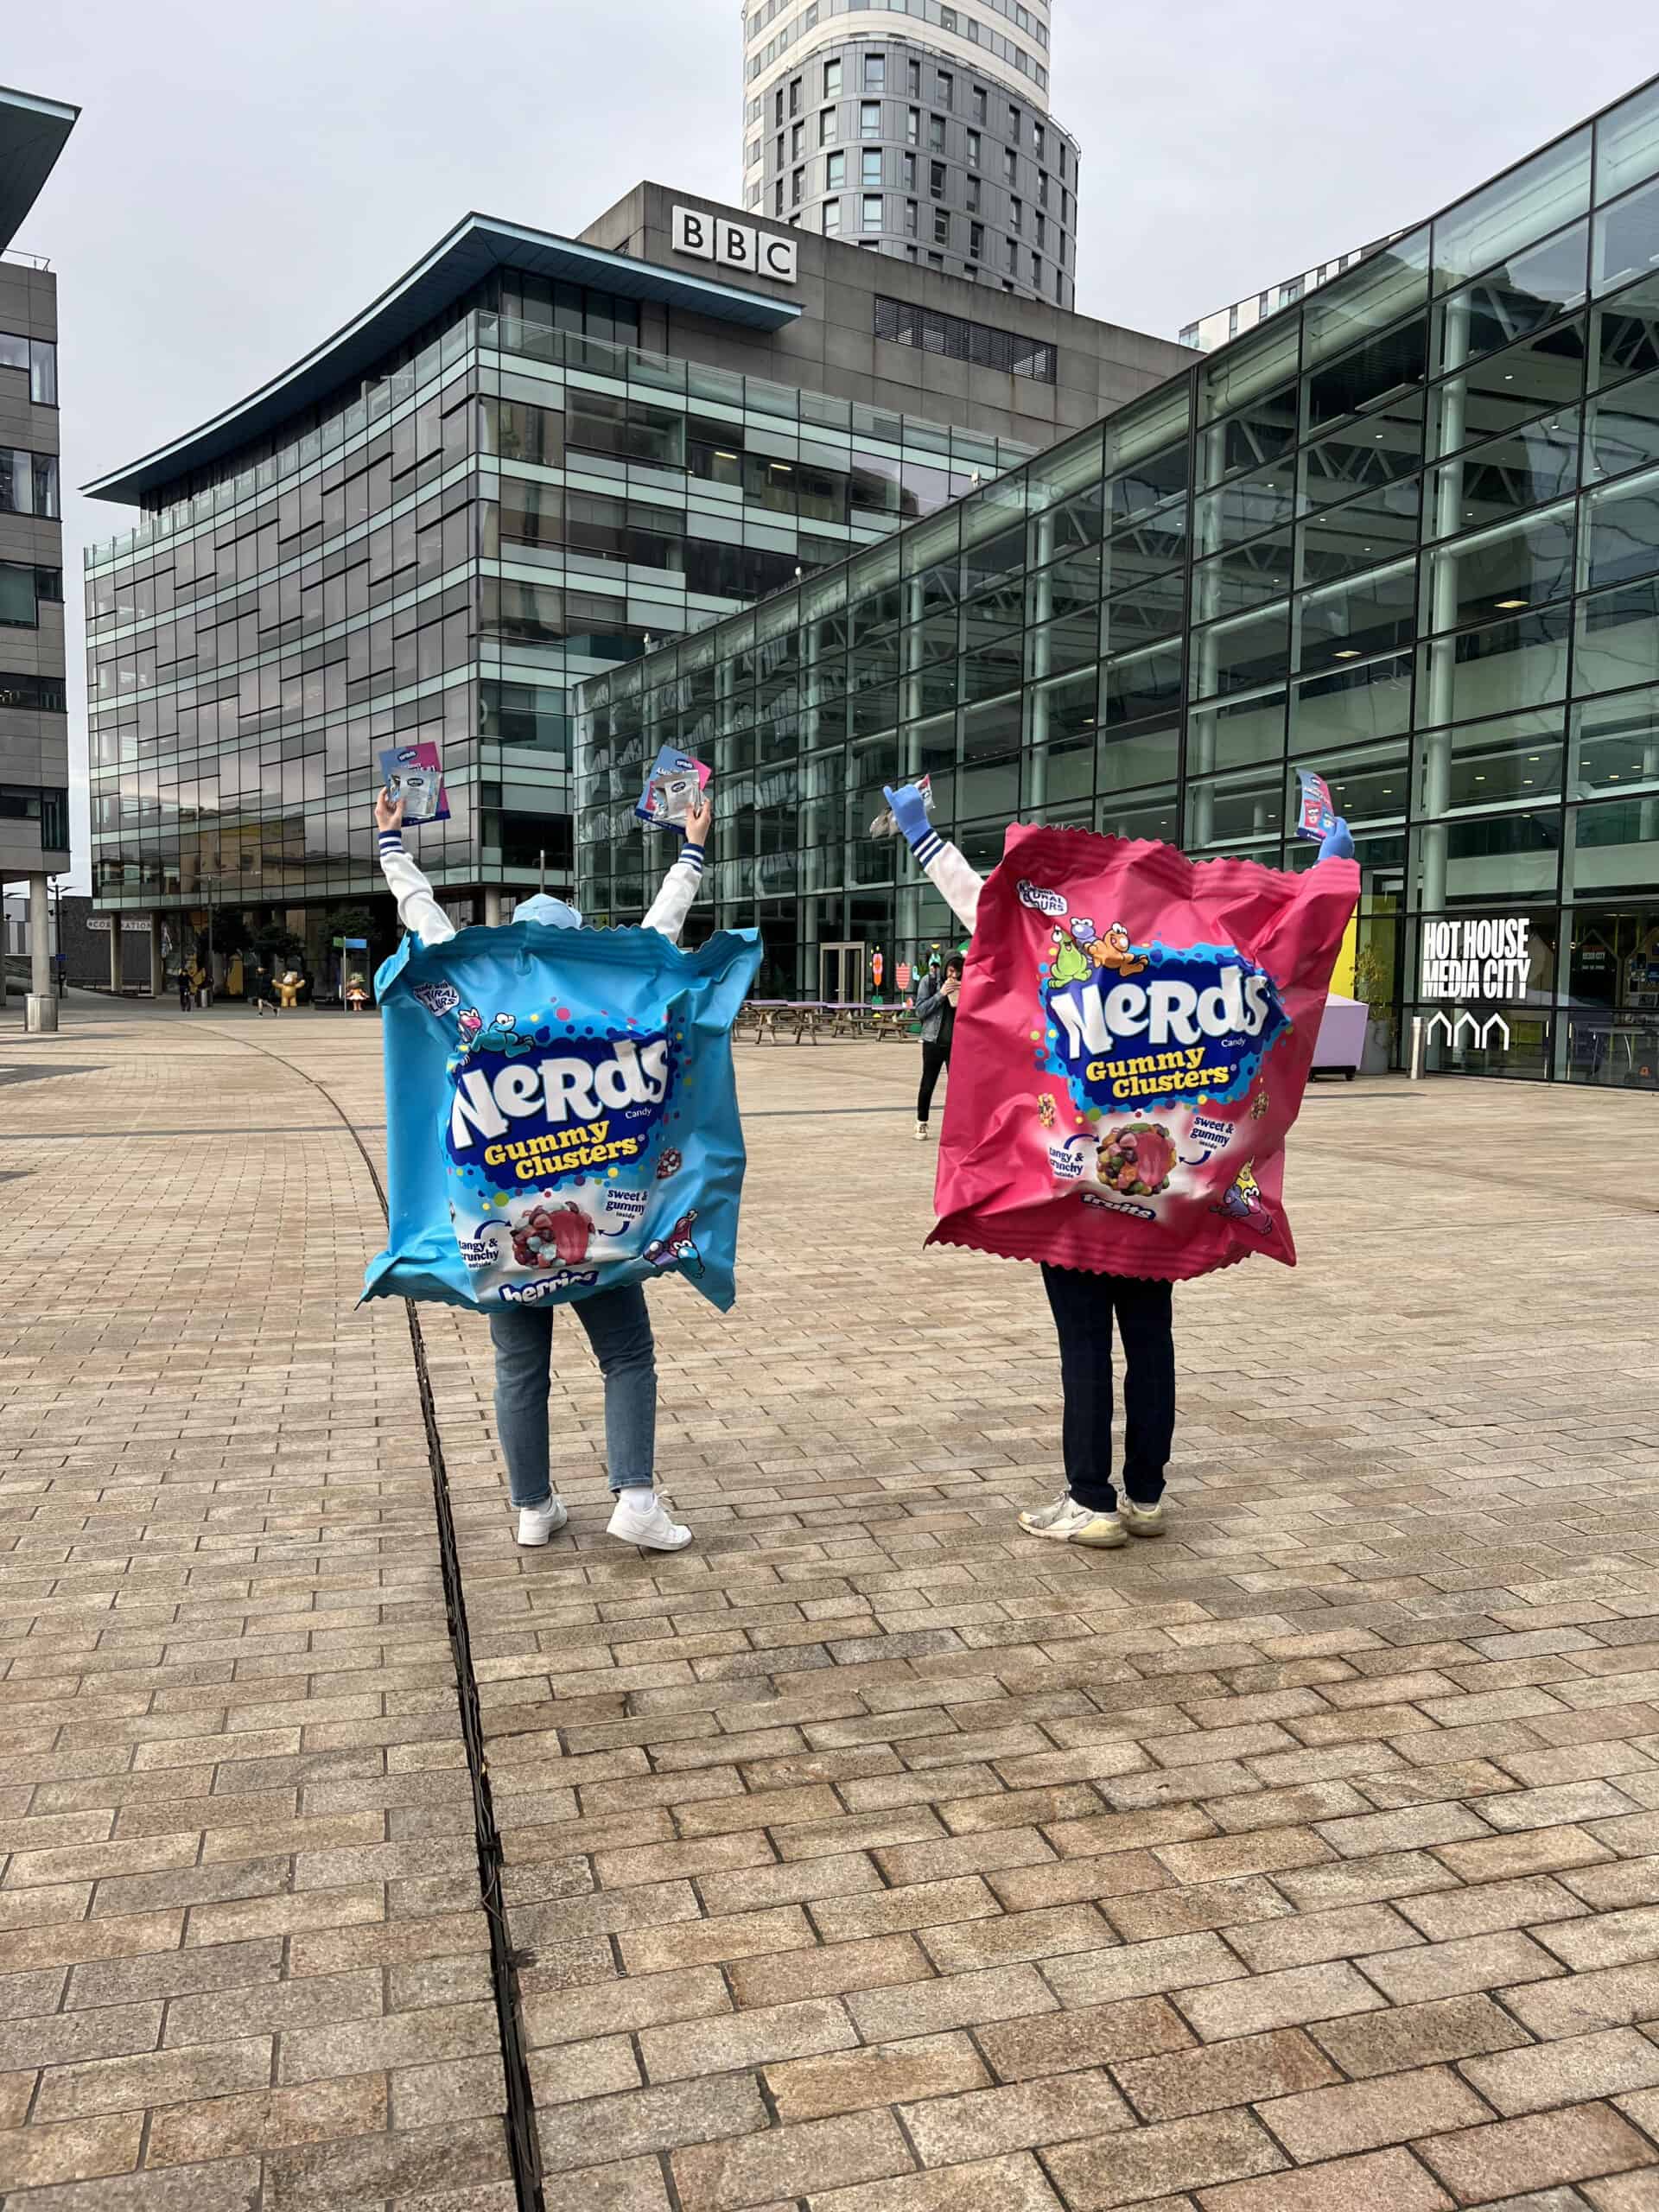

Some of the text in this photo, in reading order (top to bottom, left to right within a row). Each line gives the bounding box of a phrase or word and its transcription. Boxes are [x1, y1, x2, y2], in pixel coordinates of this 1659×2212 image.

[683, 213, 791, 275] BBC
[1423, 918, 1529, 959] HOT HOUSE
[1422, 958, 1531, 999] MEDIA CITY
[1221, 1037, 1246, 1047] Candy
[1086, 1046, 1205, 1082] Gummy
[625, 1107, 652, 1119] Candy
[1194, 1116, 1234, 1134] sweet &
[485, 1120, 609, 1166] Gummy
[1190, 1128, 1230, 1147] gummy
[1074, 1152, 1085, 1162] &
[607, 1189, 640, 1202] sweet
[606, 1200, 645, 1217] gummy
[458, 1237, 499, 1253] tangy &
